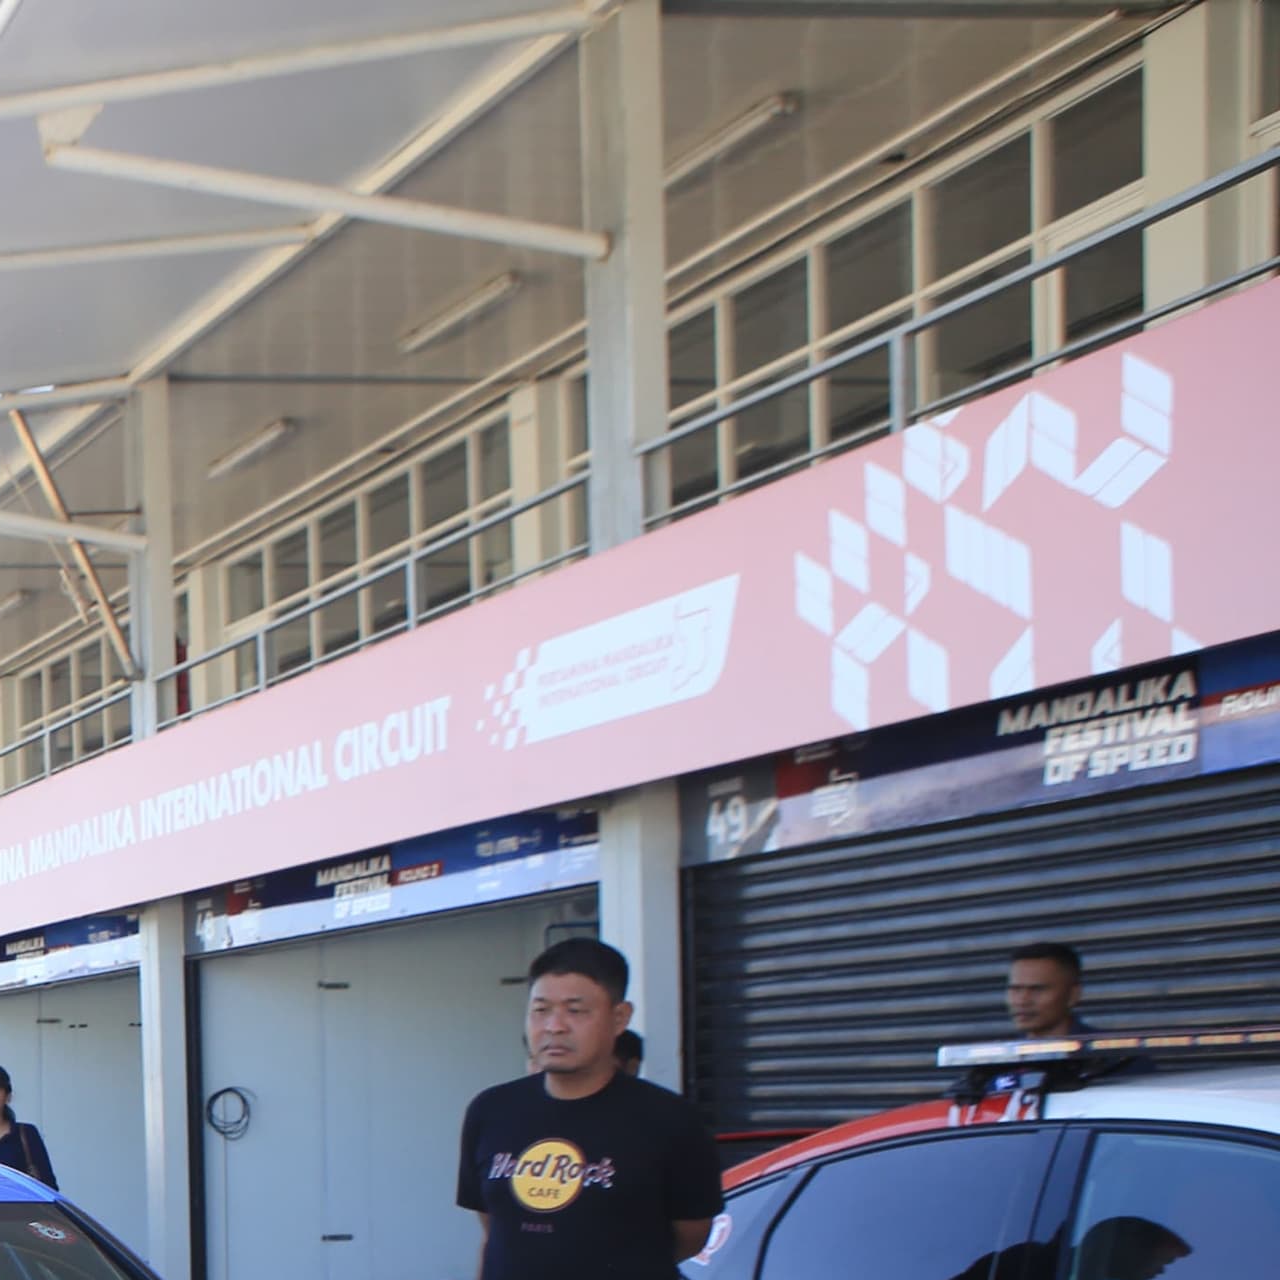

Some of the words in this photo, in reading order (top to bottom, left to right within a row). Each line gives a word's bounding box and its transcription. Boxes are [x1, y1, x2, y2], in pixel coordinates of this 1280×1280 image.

[997, 670, 1197, 737] MANDALIKA
[1044, 702, 1199, 755] FESTIVAL
[1043, 752, 1088, 786] OF
[1087, 732, 1196, 778] SPEED
[28, 805, 137, 877] MANDALIKA
[140, 746, 329, 842] INTERNATIONAL
[333, 696, 452, 782] CIRCUIT
[489, 1153, 552, 1180] Hard
[551, 1154, 616, 1188] Rock
[528, 1186, 561, 1199] CAFE
